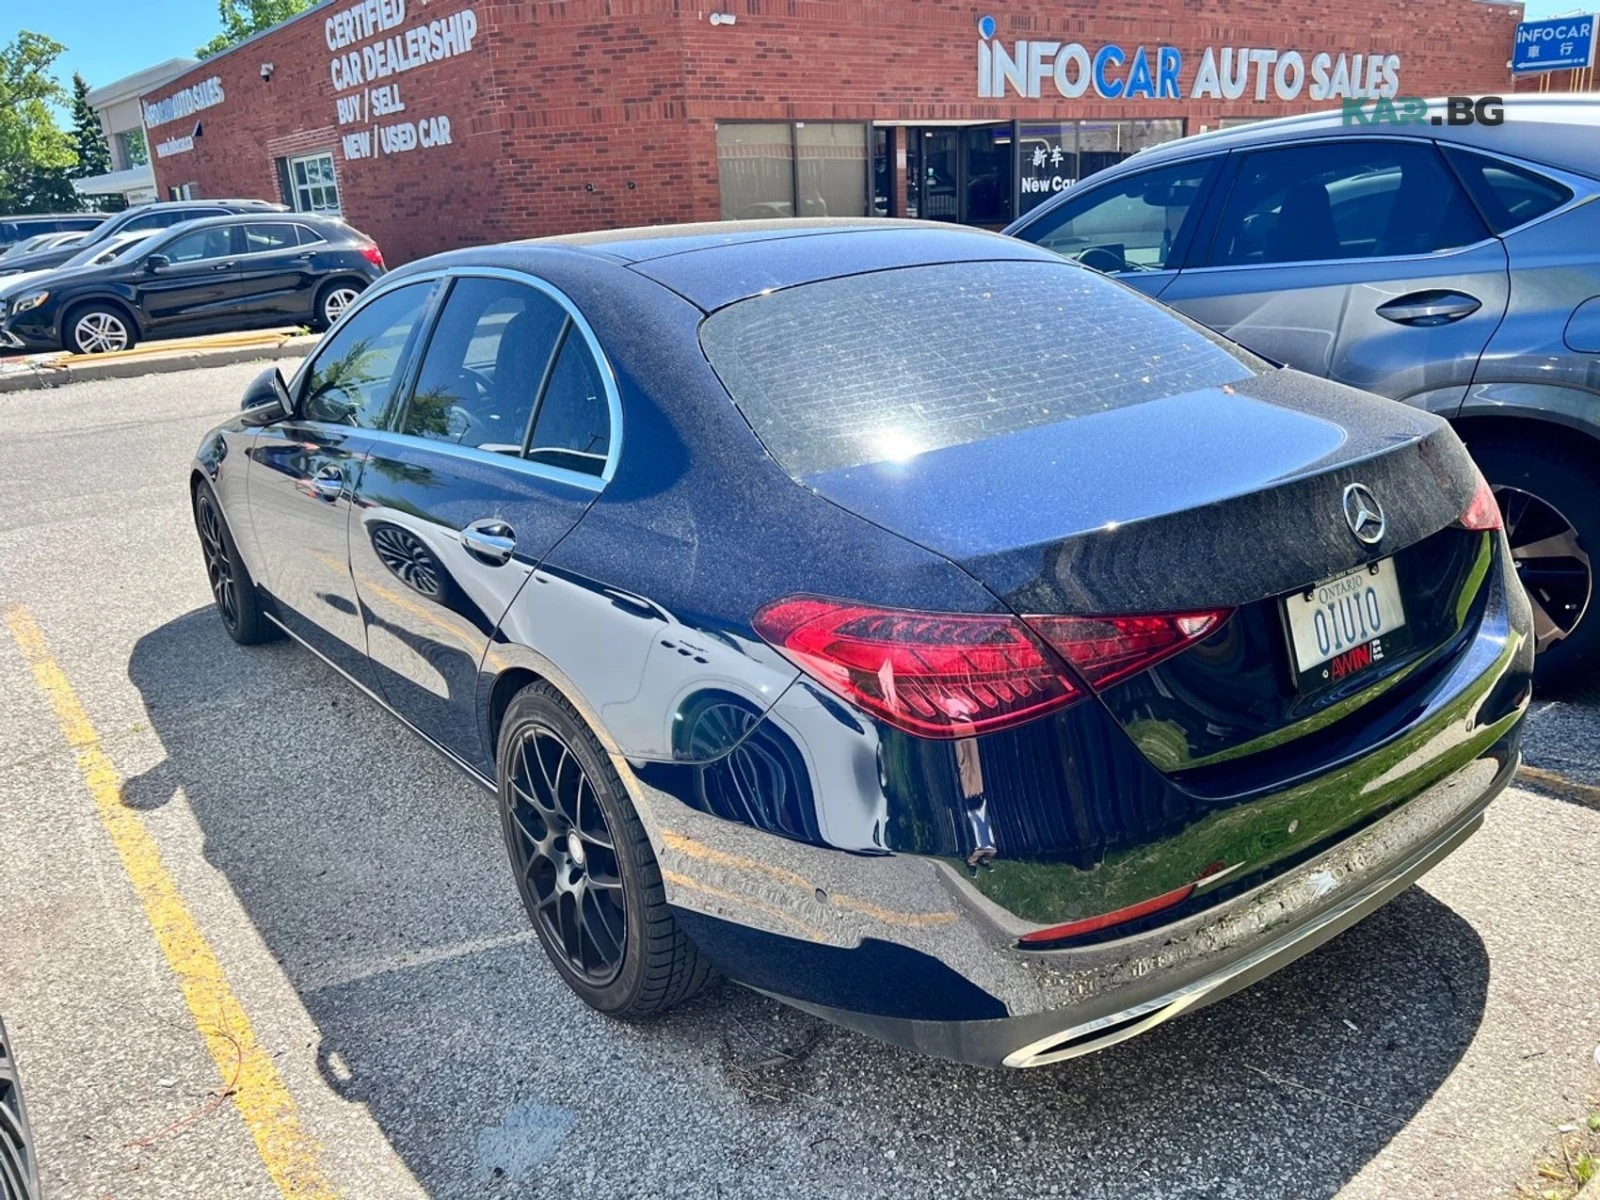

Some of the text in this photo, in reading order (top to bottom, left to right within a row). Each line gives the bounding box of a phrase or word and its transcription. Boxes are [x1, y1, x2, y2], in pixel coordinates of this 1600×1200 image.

[325, 0, 406, 51] CERTIFIED
[331, 9, 477, 91] CAR DEALERSHIP
[1190, 46, 1305, 100] AUTO
[1309, 52, 1400, 101] SALES
[336, 94, 361, 125] BUY
[371, 83, 405, 117] SELL
[342, 131, 371, 160] NEW
[380, 122, 418, 154] USED
[418, 116, 453, 148] CAR
[1032, 145, 1064, 168] 新车
[1021, 177, 1050, 193] New
